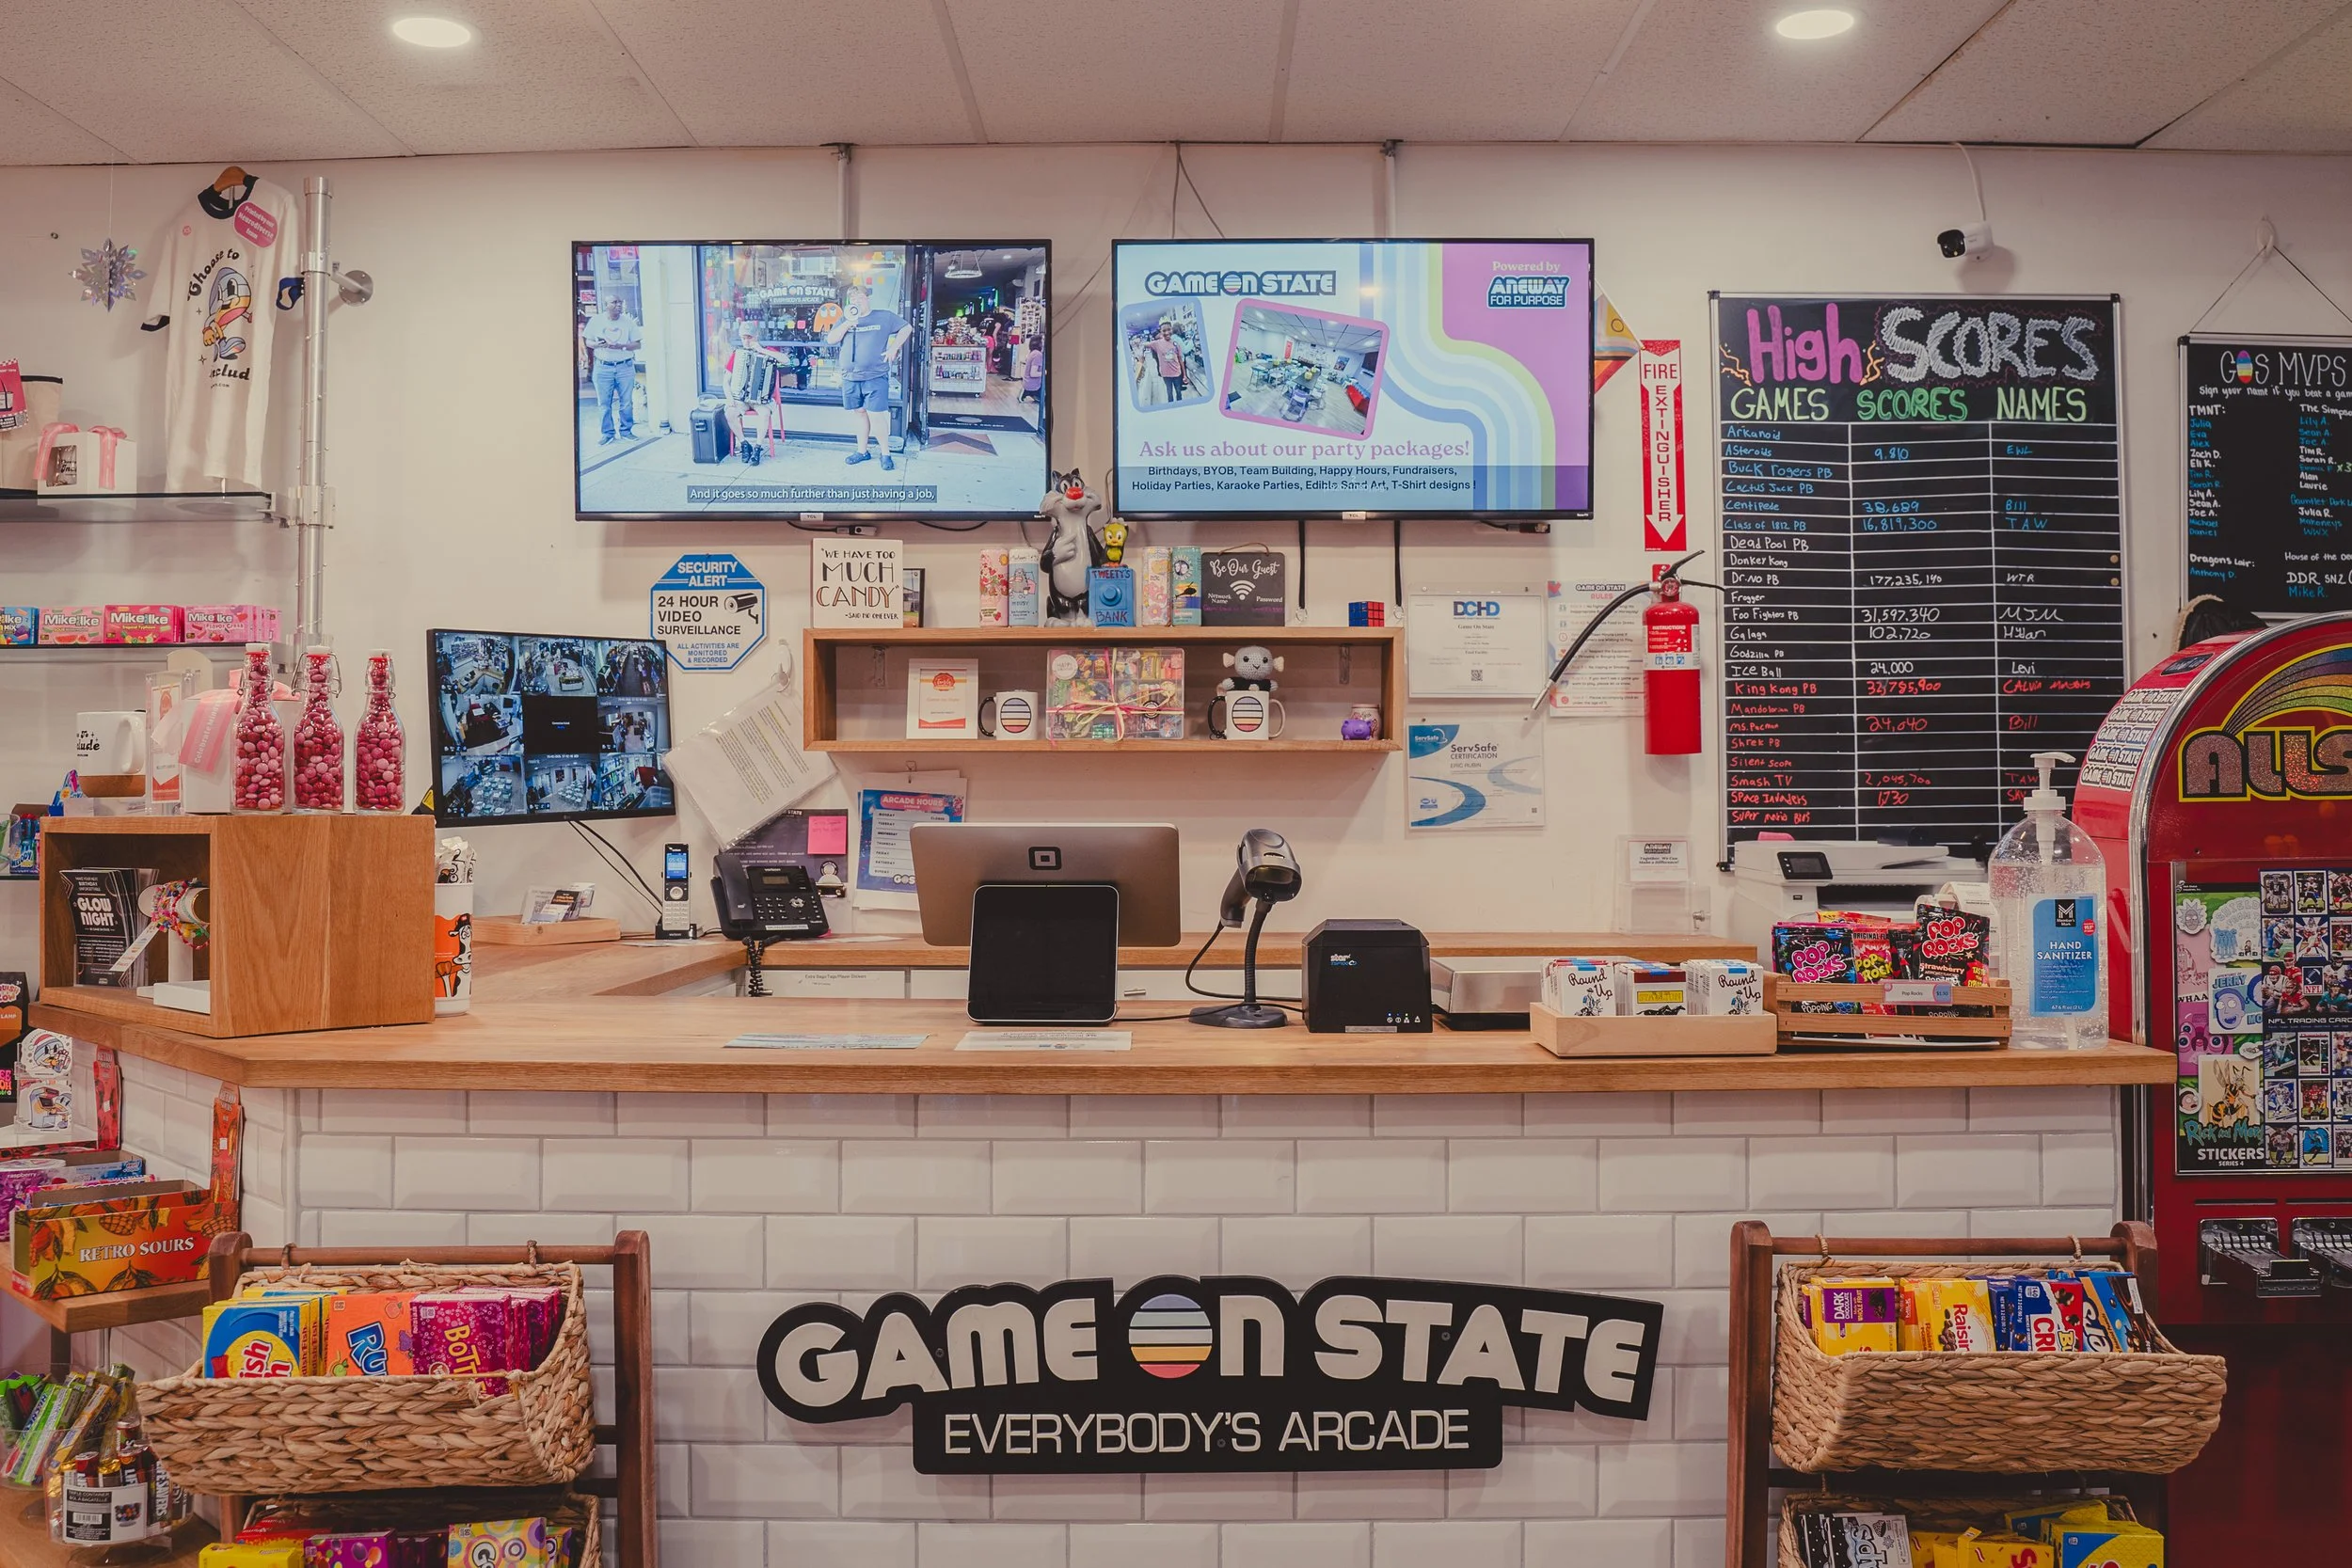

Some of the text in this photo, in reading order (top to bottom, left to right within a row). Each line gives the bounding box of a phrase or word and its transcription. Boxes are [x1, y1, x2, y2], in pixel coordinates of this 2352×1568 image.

[238, 212, 275, 238] Neurodiverse
[227, 248, 239, 260] to
[1492, 261, 1562, 274] Powered by
[1147, 274, 1218, 293] GAME
[1262, 274, 1333, 293] STATE
[1490, 295, 1563, 306] FOR PURPOSE
[1747, 303, 2099, 384] High SCORES
[1644, 363, 1677, 379] FIRE
[2221, 386, 2324, 401] your name you beat
[1731, 388, 1829, 420] GAMES
[1856, 387, 1967, 420] SCORES
[1997, 387, 2087, 421] NAMES
[1727, 424, 1781, 440] Arkanoid
[1139, 440, 1470, 461] Ask us about our party packages!
[1655, 385, 1671, 522] EXTINGUISHER
[1148, 466, 1457, 477] Birthdays, BYOB, Team Building, Happy Hours, Fundraisers,
[1132, 481, 1172, 492] Holiday
[1174, 481, 1215, 491] Parties,
[1216, 481, 1260, 490] Karaoke
[1263, 481, 1303, 491] Parties,
[1305, 480, 1338, 490] Edible
[1370, 480, 1389, 491] Art,
[1391, 480, 1426, 490] T-Shirt
[1429, 480, 1470, 492] designs
[690, 488, 935, 502] And it goes so much further than just having a job,
[1724, 499, 1780, 512] Centipede
[1724, 518, 1767, 531] Class of
[1730, 536, 1810, 551] Dead Pool PB
[843, 550, 872, 559] HAVE
[875, 550, 896, 560] TOO
[1730, 553, 1769, 567] Donkey
[677, 561, 738, 574] SECURITY
[822, 562, 894, 583] MUCH
[1091, 568, 1131, 579] TWEETY'S
[1209, 558, 1280, 579] Be Our Guest
[688, 575, 728, 587] ALERT
[2285, 571, 2321, 585] DDR
[658, 595, 719, 608] 24 HOUR
[1730, 592, 1766, 605] Frogger
[1453, 600, 1501, 617] DCHD
[1731, 609, 1751, 621] Foo
[111, 612, 145, 624] Mike
[658, 610, 702, 623] VIDEO
[1095, 610, 1128, 624] BANK
[657, 625, 741, 635] SURVEILLANCE
[1730, 628, 1768, 641] Galaga
[2011, 661, 2036, 674] Levi
[1735, 682, 1817, 697] King Kong PB
[1450, 742, 1498, 752] ServSafe
[1730, 774, 1793, 787] Smash TV
[882, 796, 944, 807] ARCADE HOURS
[77, 896, 112, 912] GLOW
[80, 911, 114, 927] NIGHT
[1927, 916, 1965, 940] POP
[1921, 932, 1979, 958] ROCKS
[2049, 941, 2082, 950] HAND
[1791, 941, 1830, 969] POP
[2037, 951, 2092, 960] SANITIZER
[1791, 954, 1848, 984] ROCKS
[1918, 962, 1965, 974] Strawberry
[1567, 970, 1608, 987] Round
[1718, 970, 1758, 988] Round
[2212, 974, 2247, 989] JERRY
[1593, 985, 1613, 1001] Up
[1742, 985, 1762, 1003] Up
[2197, 1148, 2265, 1161] STICKERS
[79, 1237, 195, 1263] RETRO SOURS
[1834, 1291, 1846, 1321] DARK
[774, 1297, 1098, 1408] GAME
[1314, 1292, 1645, 1405] STATE
[943, 1409, 1470, 1455] EVERYBODY'S ARCADE
